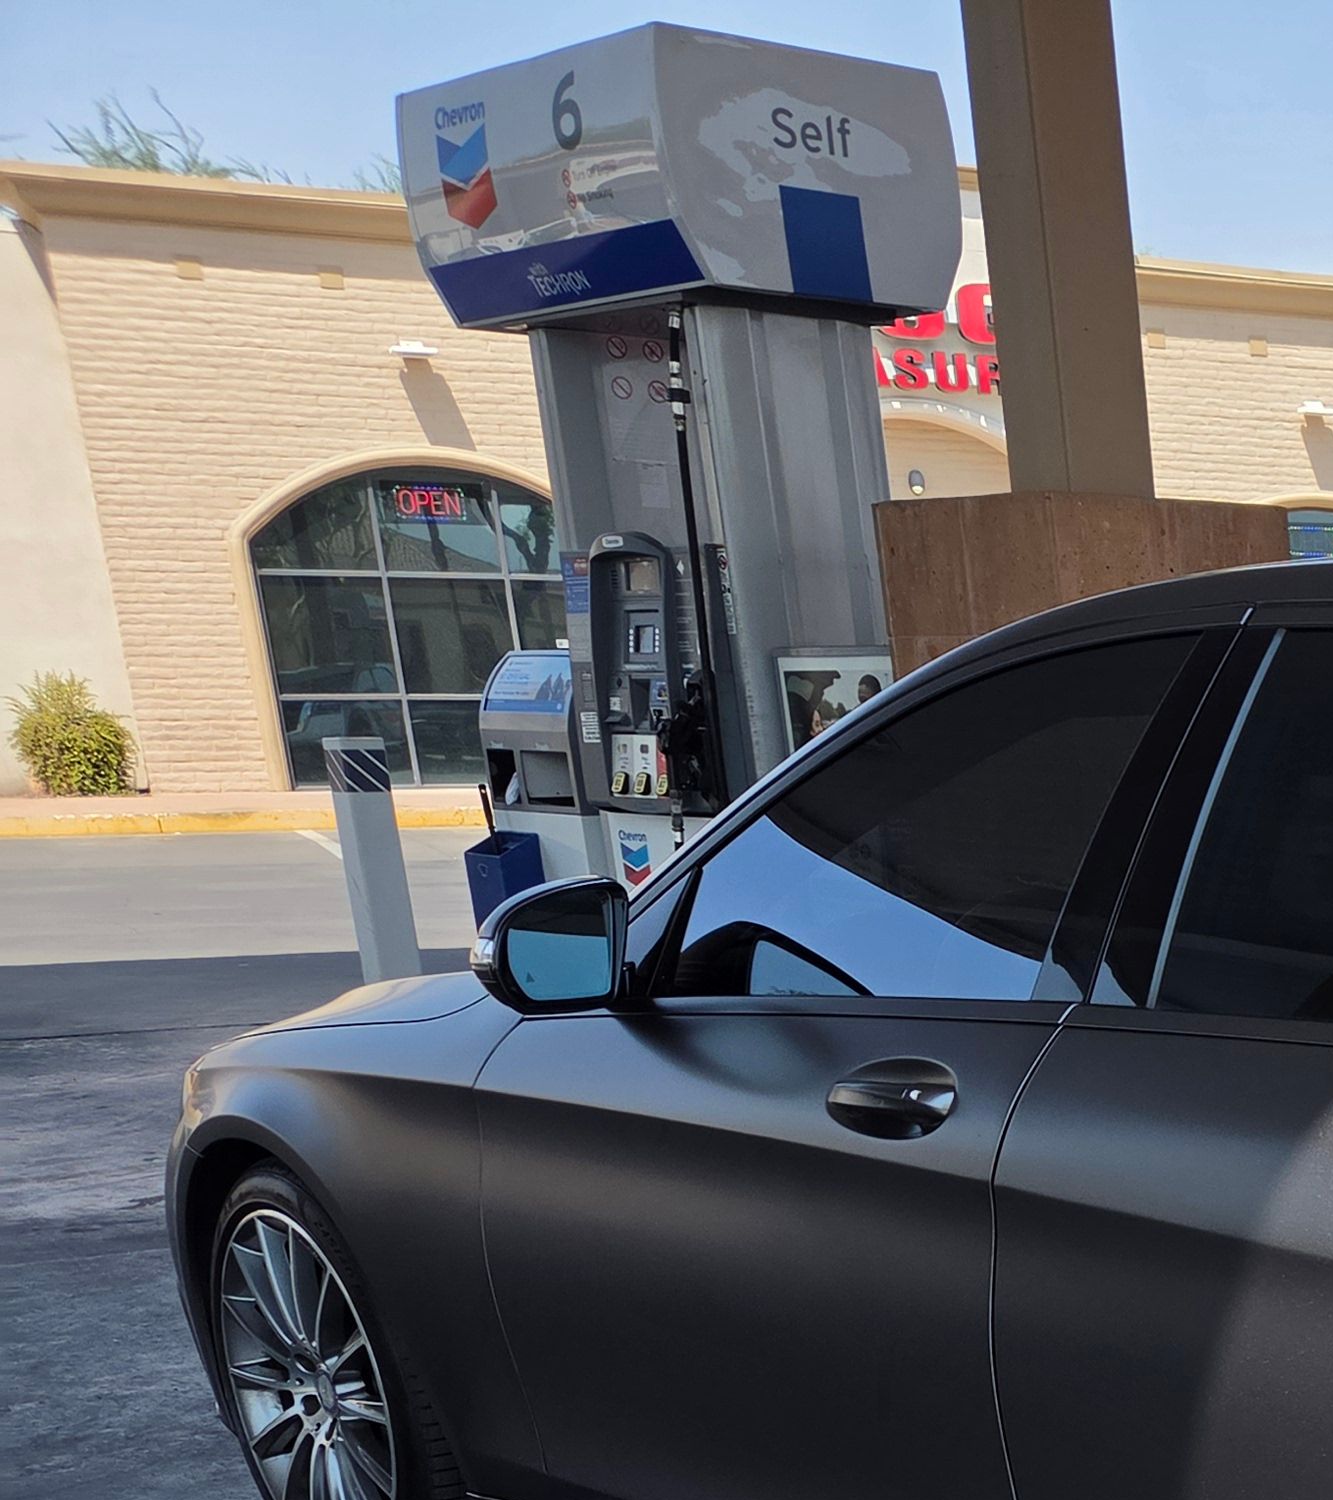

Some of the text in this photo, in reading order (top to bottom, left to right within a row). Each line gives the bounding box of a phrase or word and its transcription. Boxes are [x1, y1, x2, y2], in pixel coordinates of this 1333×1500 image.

[434, 101, 486, 131] Chevron
[552, 69, 583, 151] 6
[770, 106, 851, 158] Self
[527, 270, 592, 298] TECHRON
[399, 489, 462, 516] OPEN
[618, 829, 648, 842] Chevron
